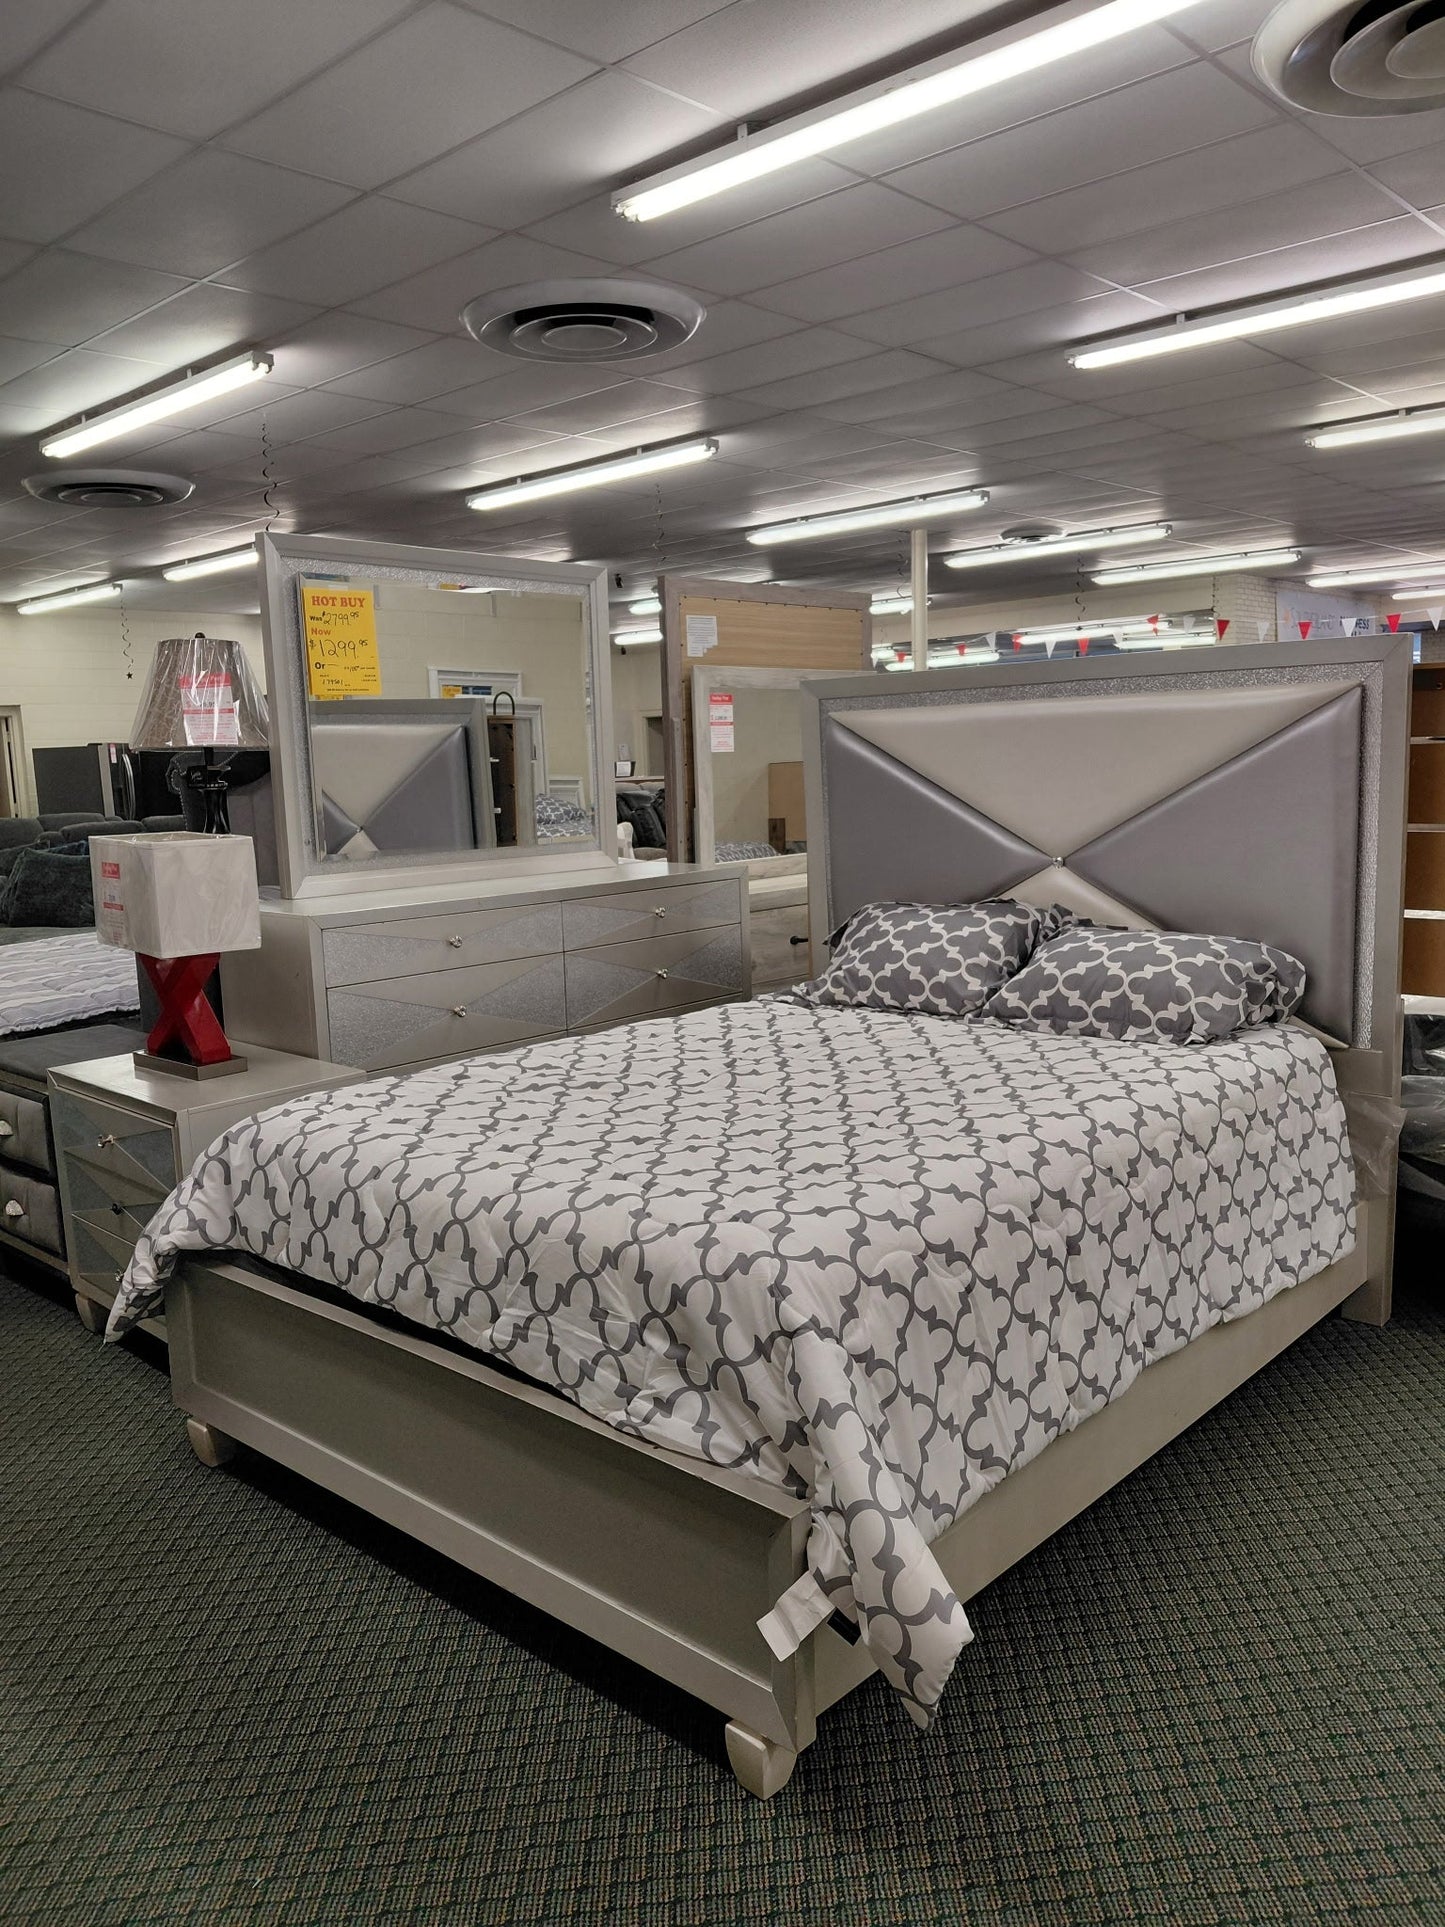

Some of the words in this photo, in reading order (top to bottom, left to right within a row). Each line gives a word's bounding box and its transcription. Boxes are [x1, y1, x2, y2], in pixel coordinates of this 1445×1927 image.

[311, 595, 337, 607] HOT
[340, 597, 366, 608] BUY
[311, 627, 332, 636] Now
[314, 661, 326, 670] Or
